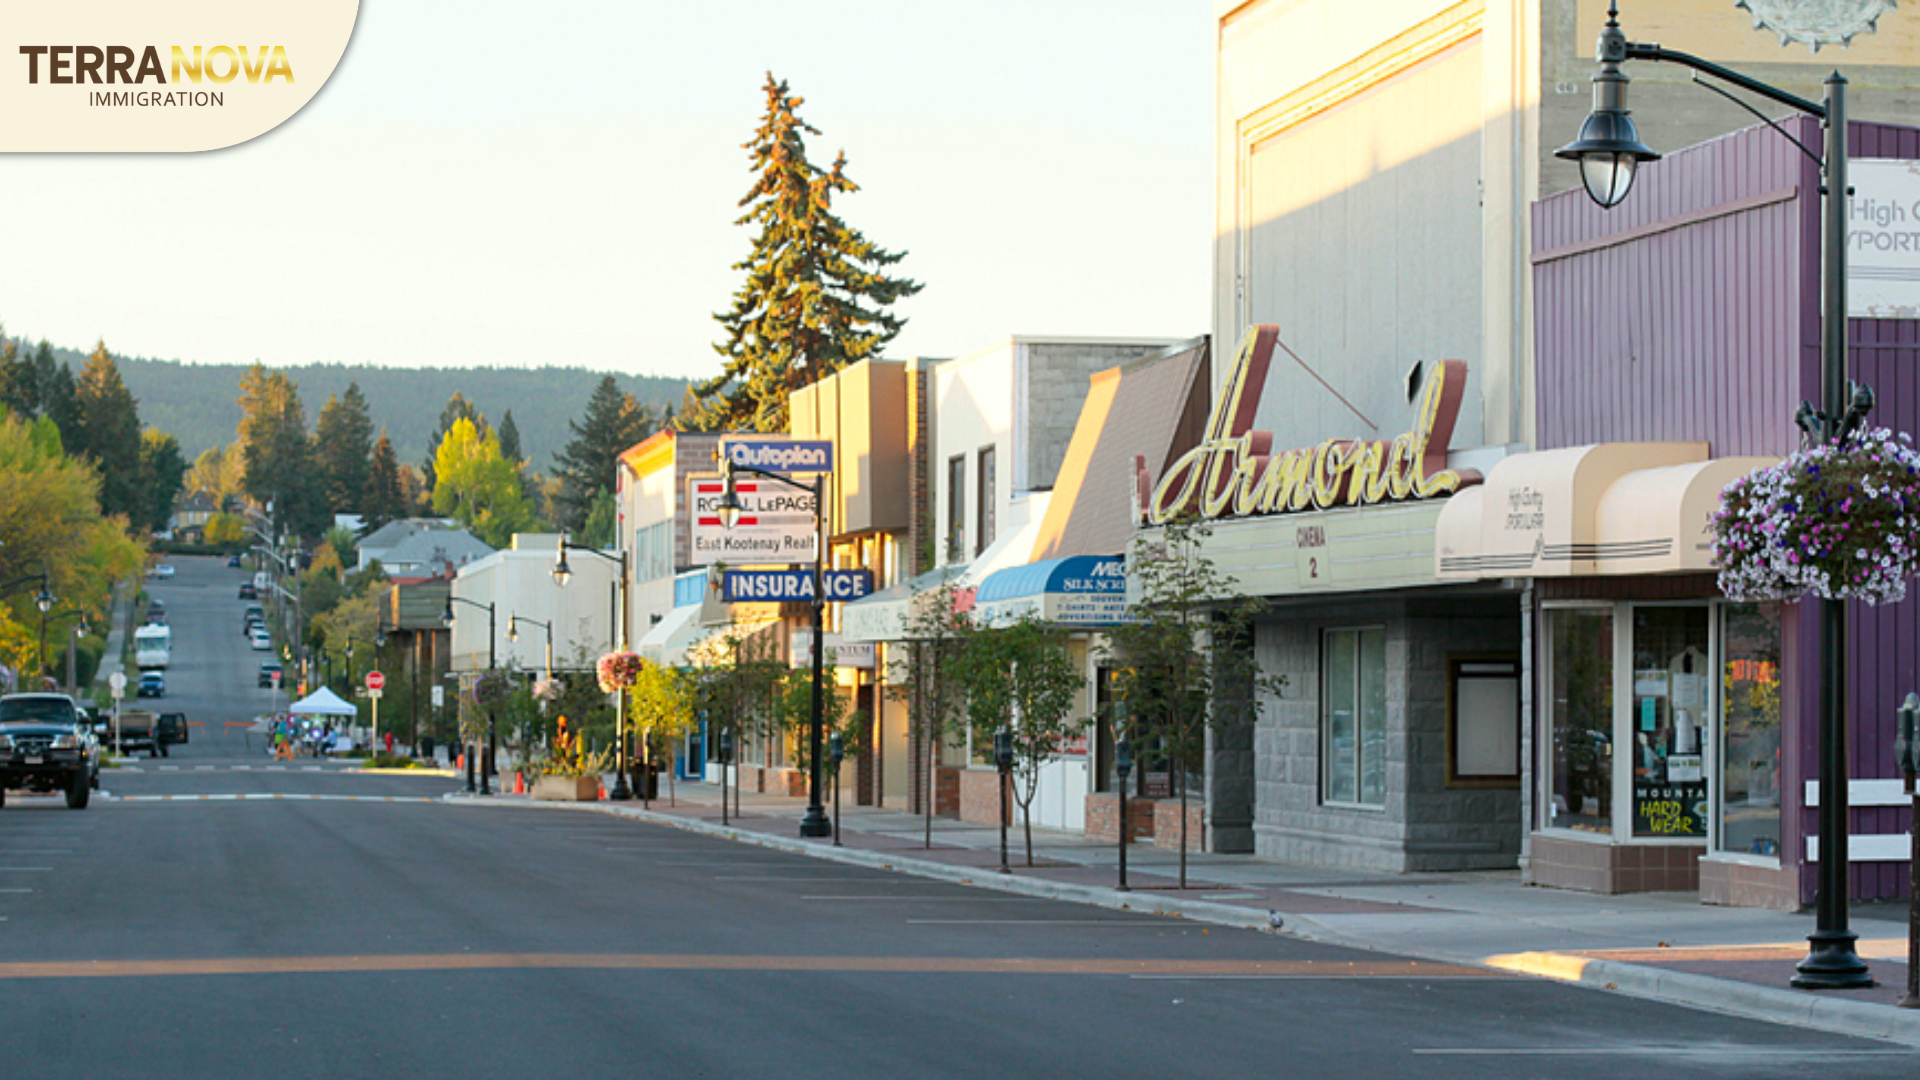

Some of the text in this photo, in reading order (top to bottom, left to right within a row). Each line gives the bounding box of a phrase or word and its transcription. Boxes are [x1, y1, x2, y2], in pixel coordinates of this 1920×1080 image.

[1850, 198, 1905, 227] High
[1150, 323, 1464, 524] Armond
[696, 535, 814, 553] East Kootenay Realt
[1309, 556, 1318, 578] 2
[731, 574, 864, 597] INSURANCE
[1063, 577, 1094, 591] SILK
[1639, 800, 1683, 817] HARD
[1649, 815, 1694, 834] WEAR
